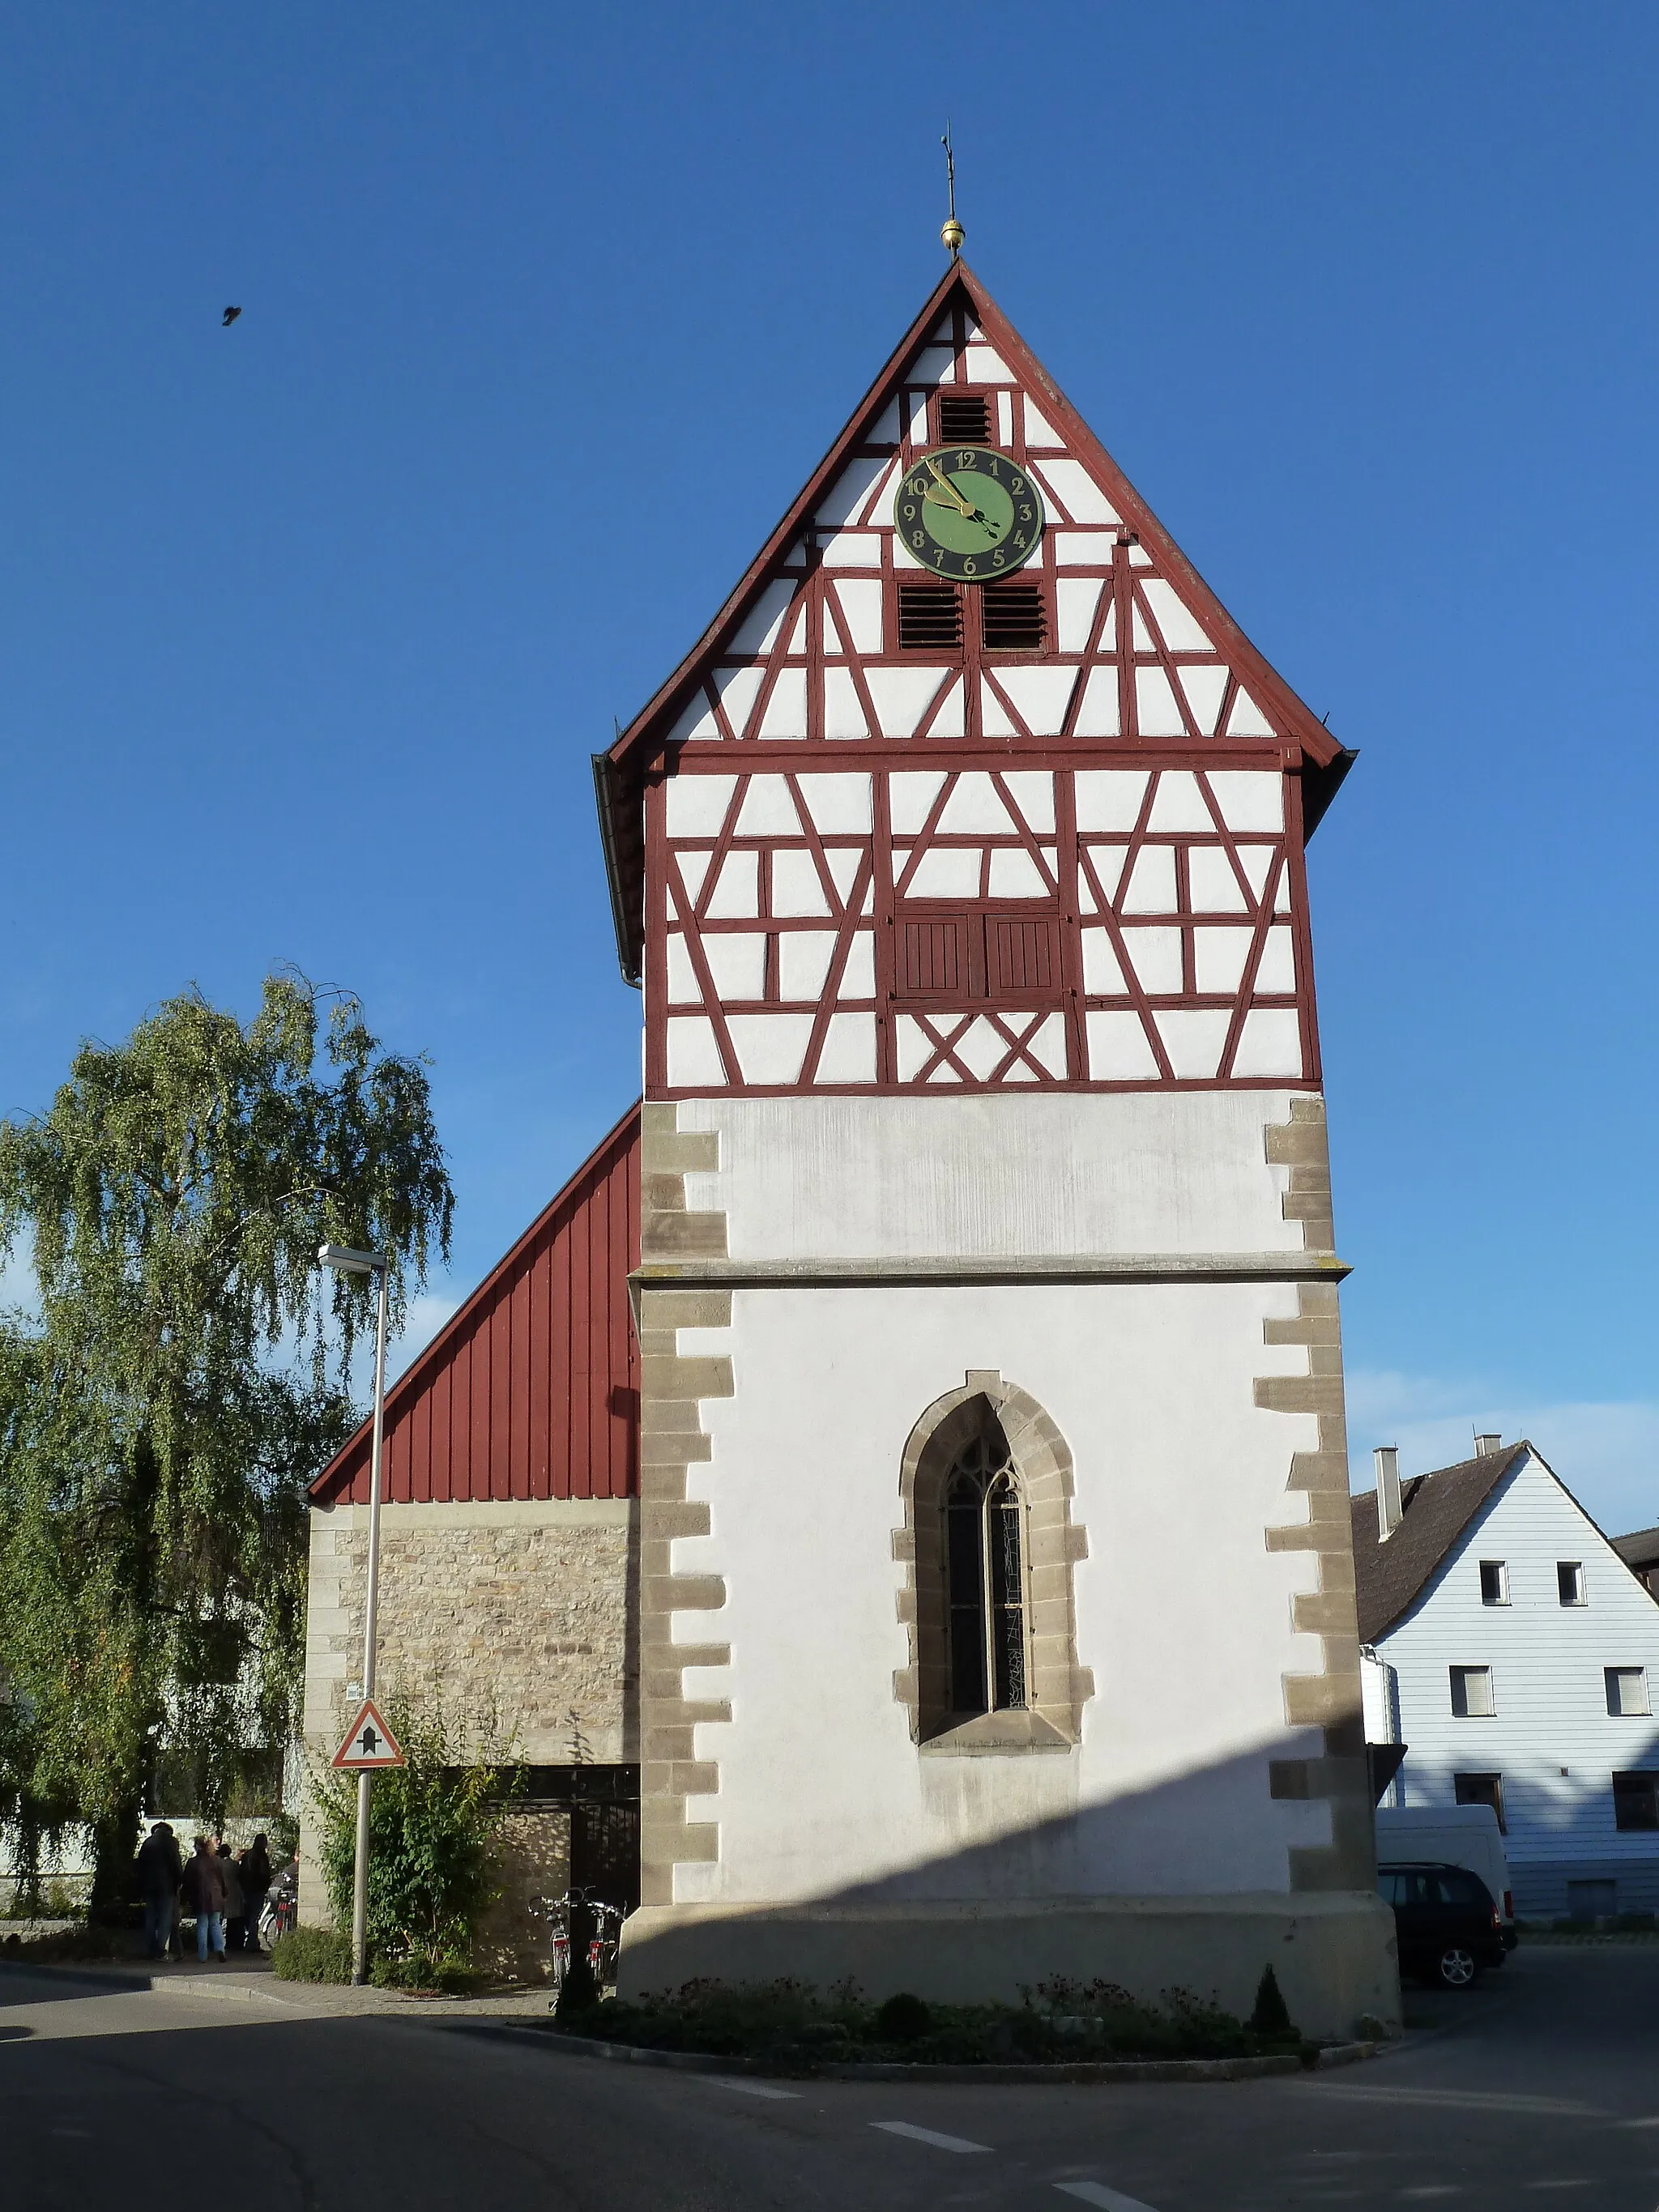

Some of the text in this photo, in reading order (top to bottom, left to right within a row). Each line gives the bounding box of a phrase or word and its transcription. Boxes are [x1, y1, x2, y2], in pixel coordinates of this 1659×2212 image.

[956, 451, 977, 470] 12
[990, 458, 999, 476] 1
[905, 478, 928, 496] 10
[1012, 478, 1025, 496] 2
[904, 505, 915, 522] 9
[1020, 504, 1032, 522] 3
[912, 531, 924, 548] 8
[1013, 530, 1026, 548] 4
[933, 549, 945, 567] 7
[964, 556, 976, 574] 6
[992, 549, 1004, 567] 5
